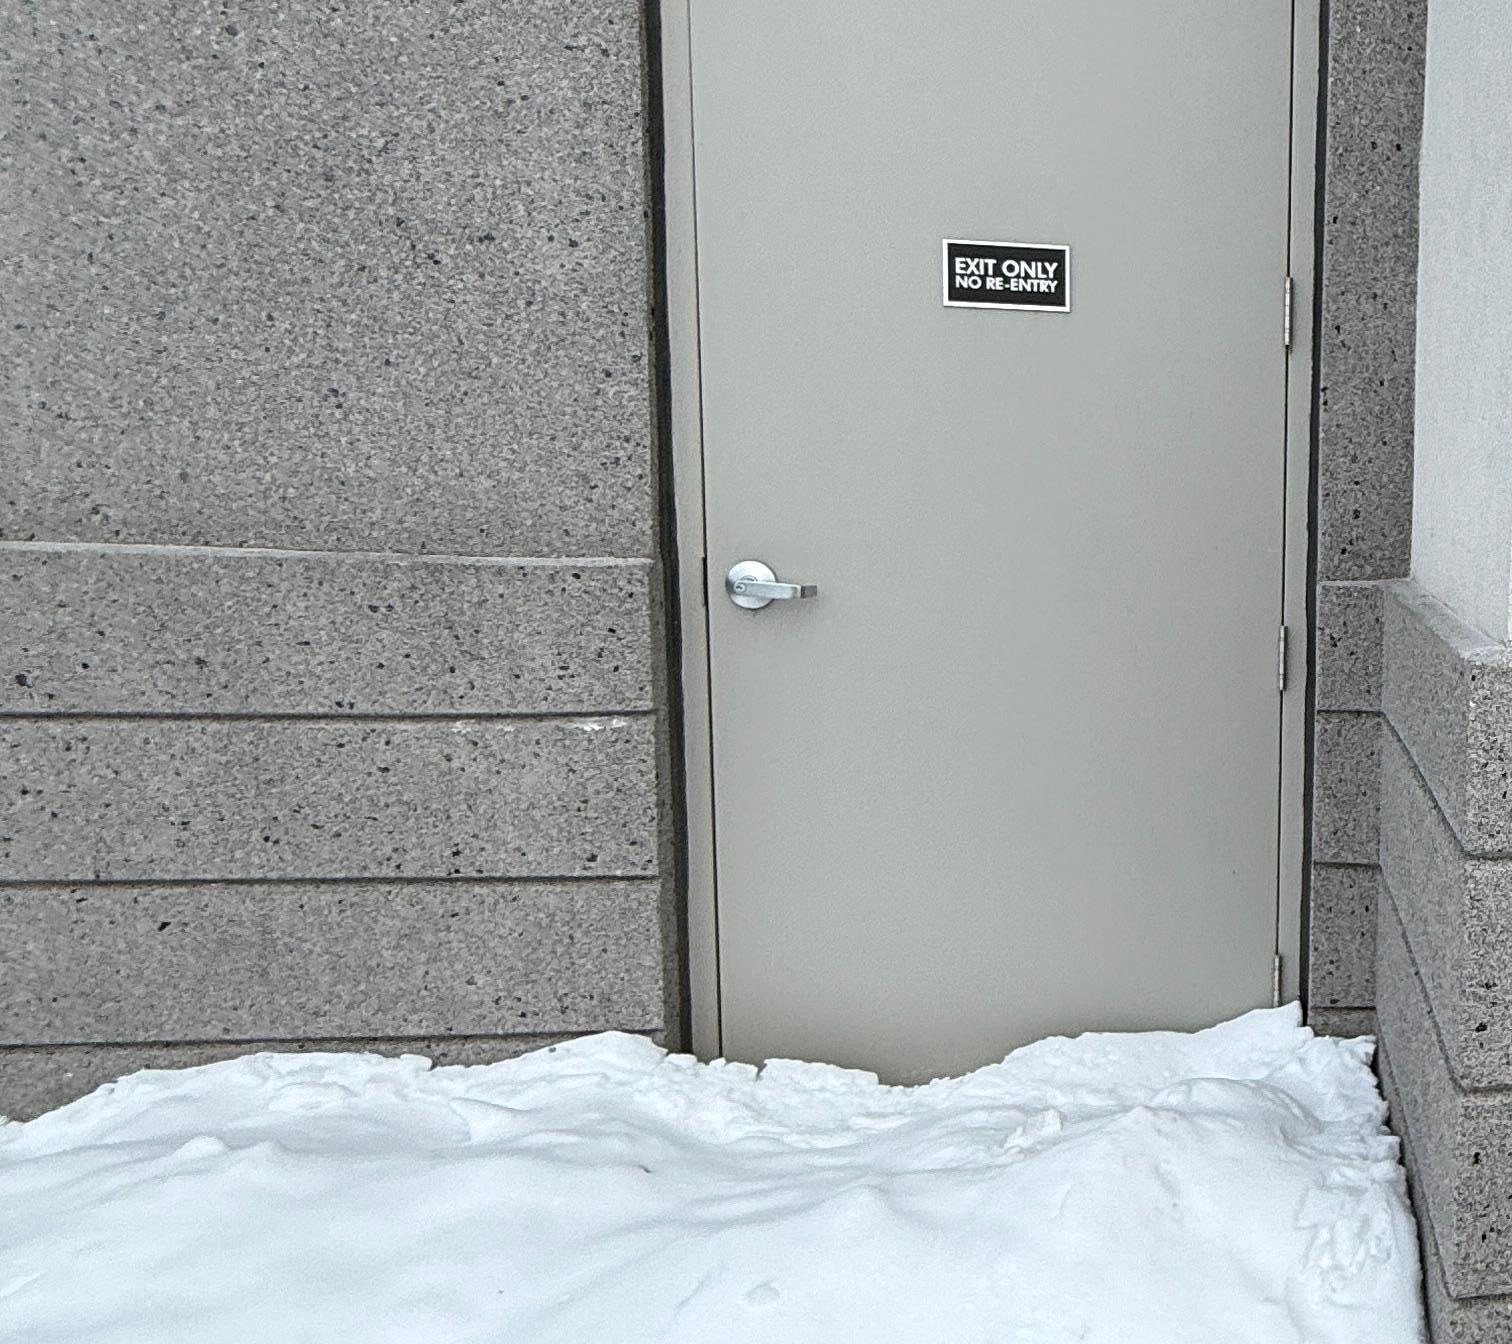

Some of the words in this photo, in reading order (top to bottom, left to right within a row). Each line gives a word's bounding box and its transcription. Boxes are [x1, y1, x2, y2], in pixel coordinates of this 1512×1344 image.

[954, 256, 997, 275] EXIT
[1001, 259, 1058, 278] ONLY
[955, 275, 982, 289] NO
[985, 277, 1058, 293] RE-ENTRY
